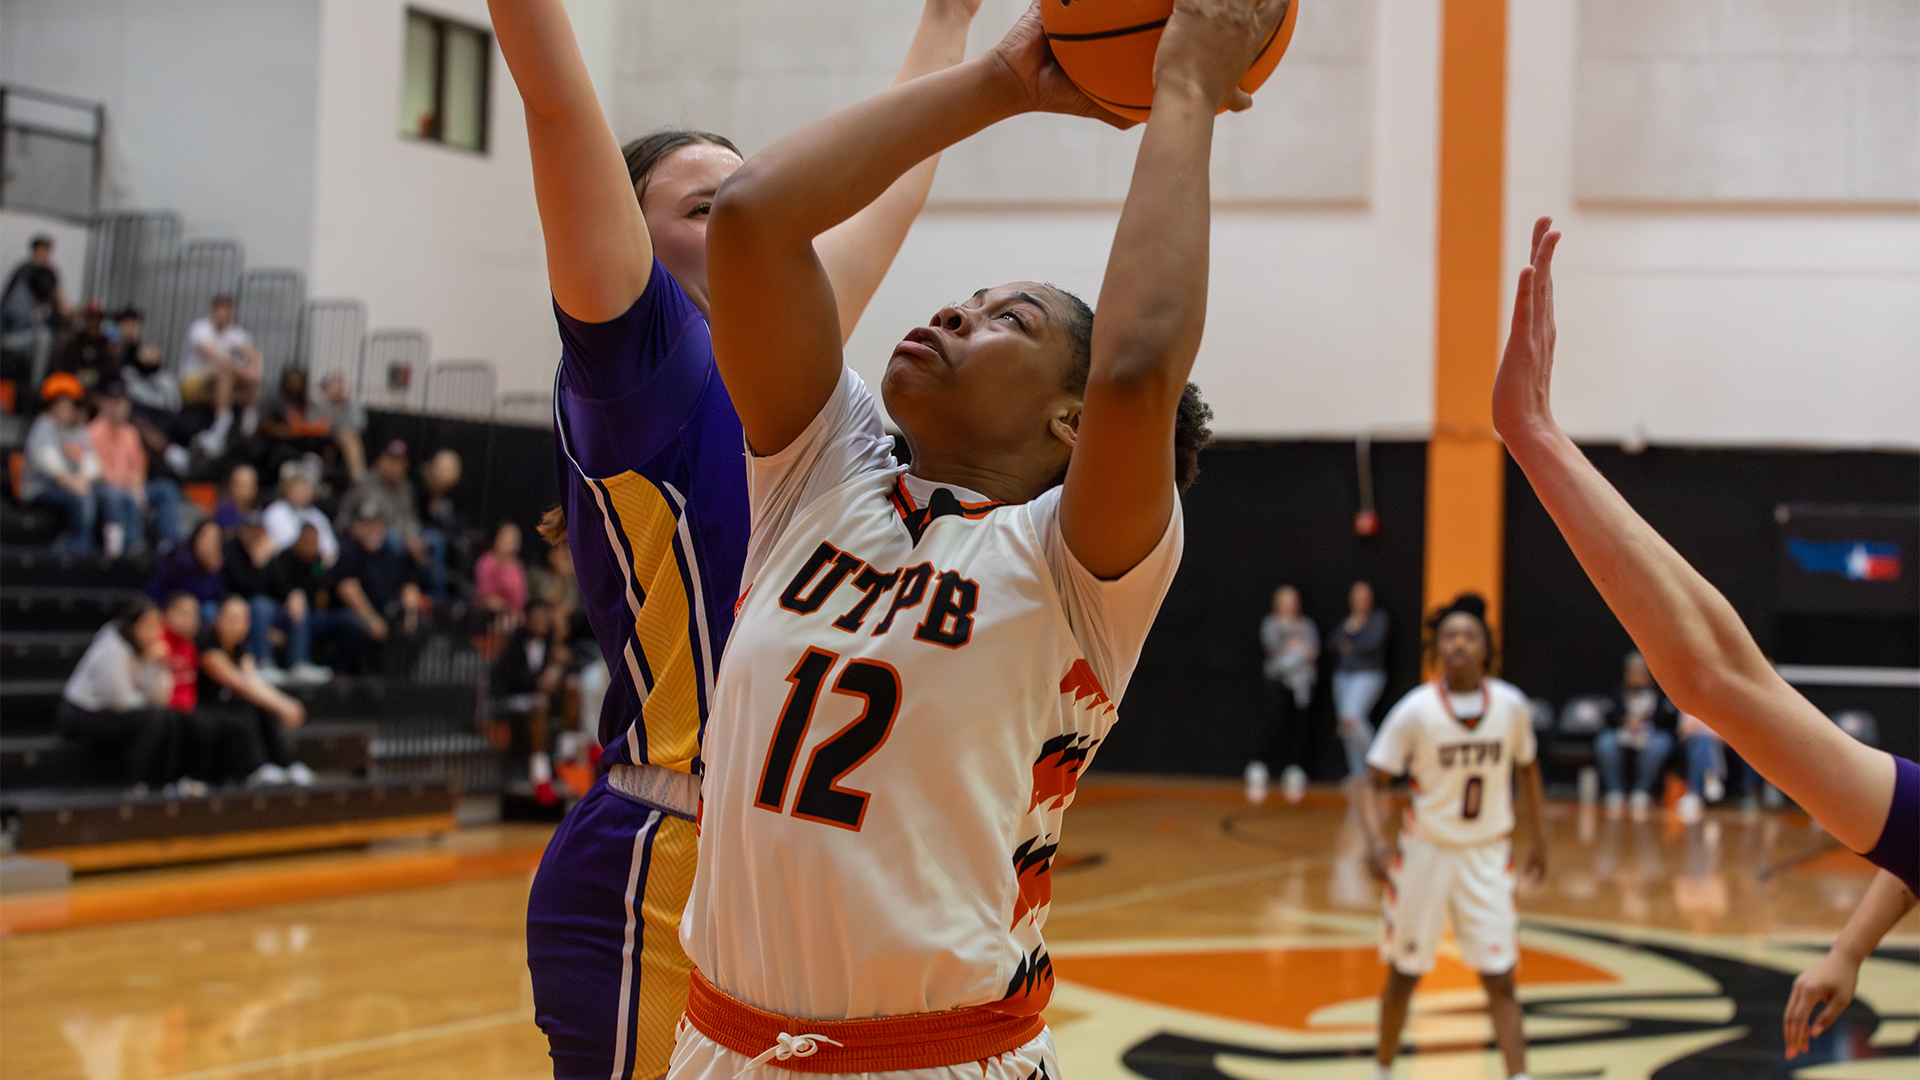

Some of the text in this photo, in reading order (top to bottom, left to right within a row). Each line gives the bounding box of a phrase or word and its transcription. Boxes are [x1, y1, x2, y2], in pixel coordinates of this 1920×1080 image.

[778, 540, 979, 649] UTPB
[754, 645, 902, 832] 12
[1462, 776, 1483, 820] 0
